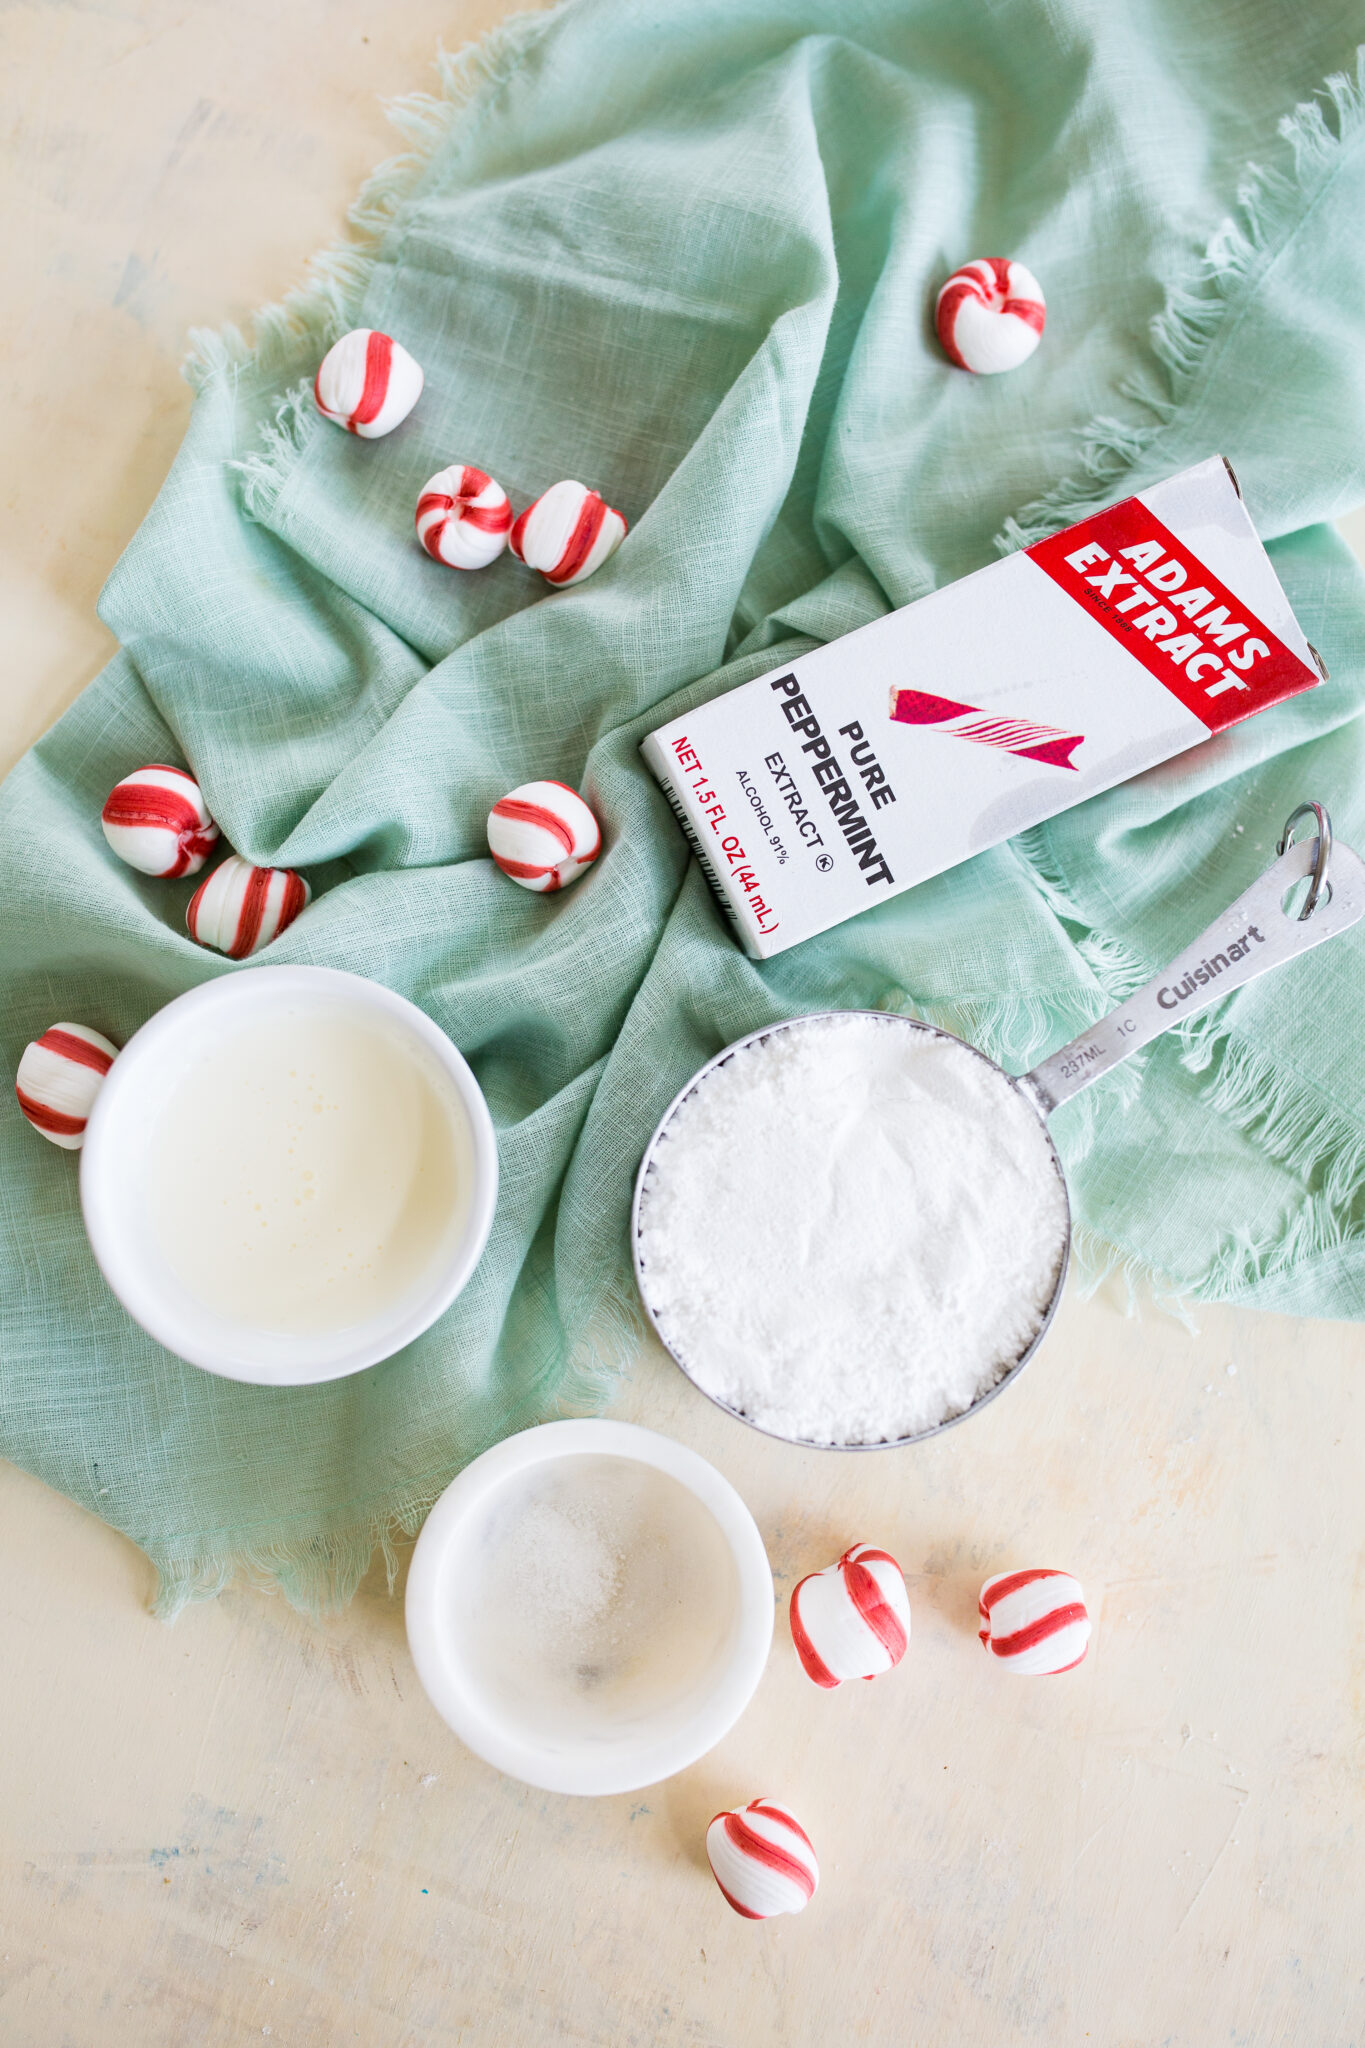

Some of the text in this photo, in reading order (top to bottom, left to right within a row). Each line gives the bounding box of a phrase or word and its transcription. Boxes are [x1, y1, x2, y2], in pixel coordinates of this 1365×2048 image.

[1064, 541, 1248, 698] EXTRACT
[1084, 588, 1112, 613] SINCE
[1118, 540, 1271, 670] ADAMS
[764, 752, 824, 848] EXTRACT
[770, 672, 895, 886] PEPPERMINT
[838, 720, 897, 811] PURE
[671, 736, 780, 934] NET 1.5 FL. OZ (44 mL.)
[735, 770, 790, 865] ALCOHOL 91%
[1156, 924, 1266, 1010] Cuisinart
[1060, 1019, 1137, 1079] 237ML 1C
